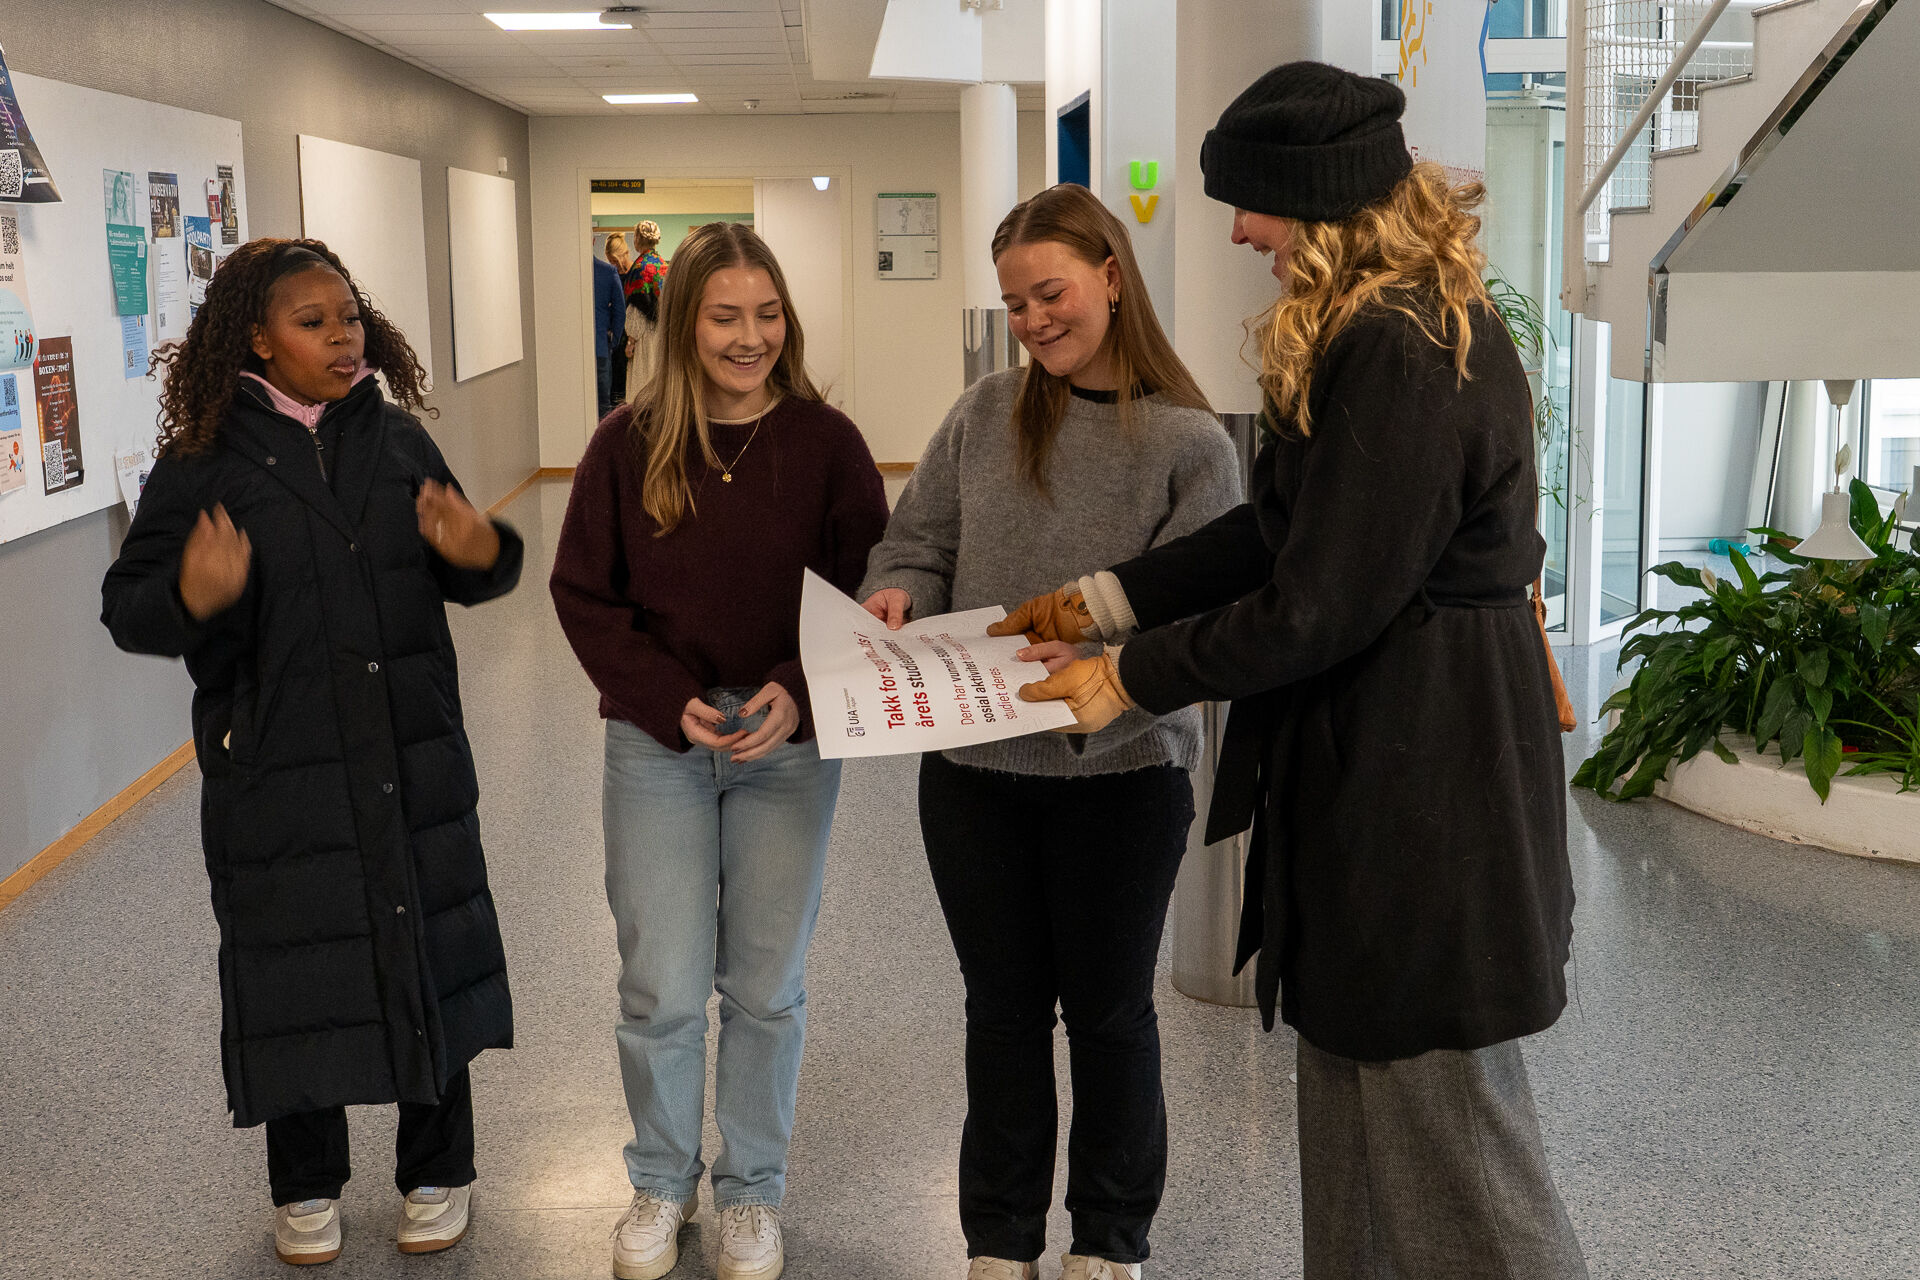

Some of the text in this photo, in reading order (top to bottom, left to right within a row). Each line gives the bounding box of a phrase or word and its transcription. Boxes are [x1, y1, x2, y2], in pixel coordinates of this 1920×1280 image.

[940, 658, 962, 682] vunnet
[962, 661, 986, 693] aktivitet
[879, 674, 898, 692] for
[953, 684, 968, 700] har
[848, 709, 860, 725] UiA
[882, 695, 906, 729] Takk
[912, 692, 935, 728] årets
[959, 703, 975, 725] Dere
[974, 696, 996, 723] sosial
[995, 692, 1018, 720] studiet
